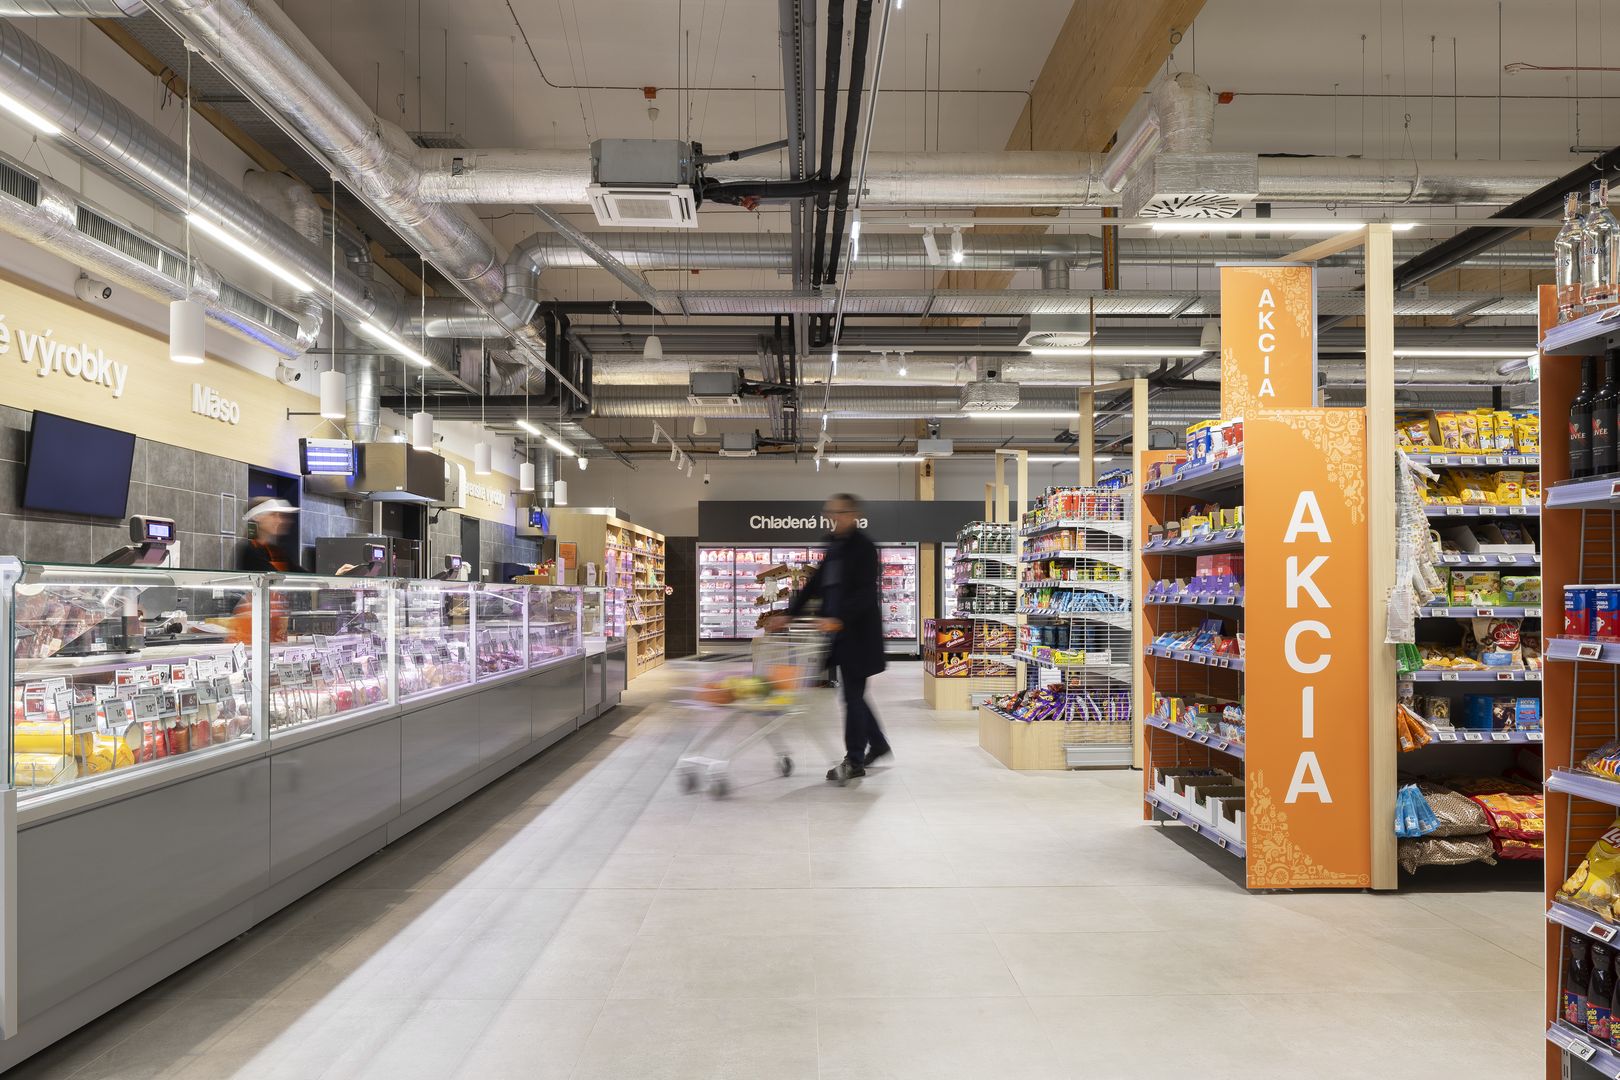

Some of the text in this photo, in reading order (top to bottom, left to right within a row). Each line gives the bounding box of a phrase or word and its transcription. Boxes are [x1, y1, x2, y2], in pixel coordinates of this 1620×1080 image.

[15, 329, 129, 399] výrobky
[1257, 288, 1276, 398] AKCIA
[191, 383, 241, 425] Mäso
[750, 514, 869, 532] Chladená hyna
[1282, 490, 1334, 804] AKCIA
